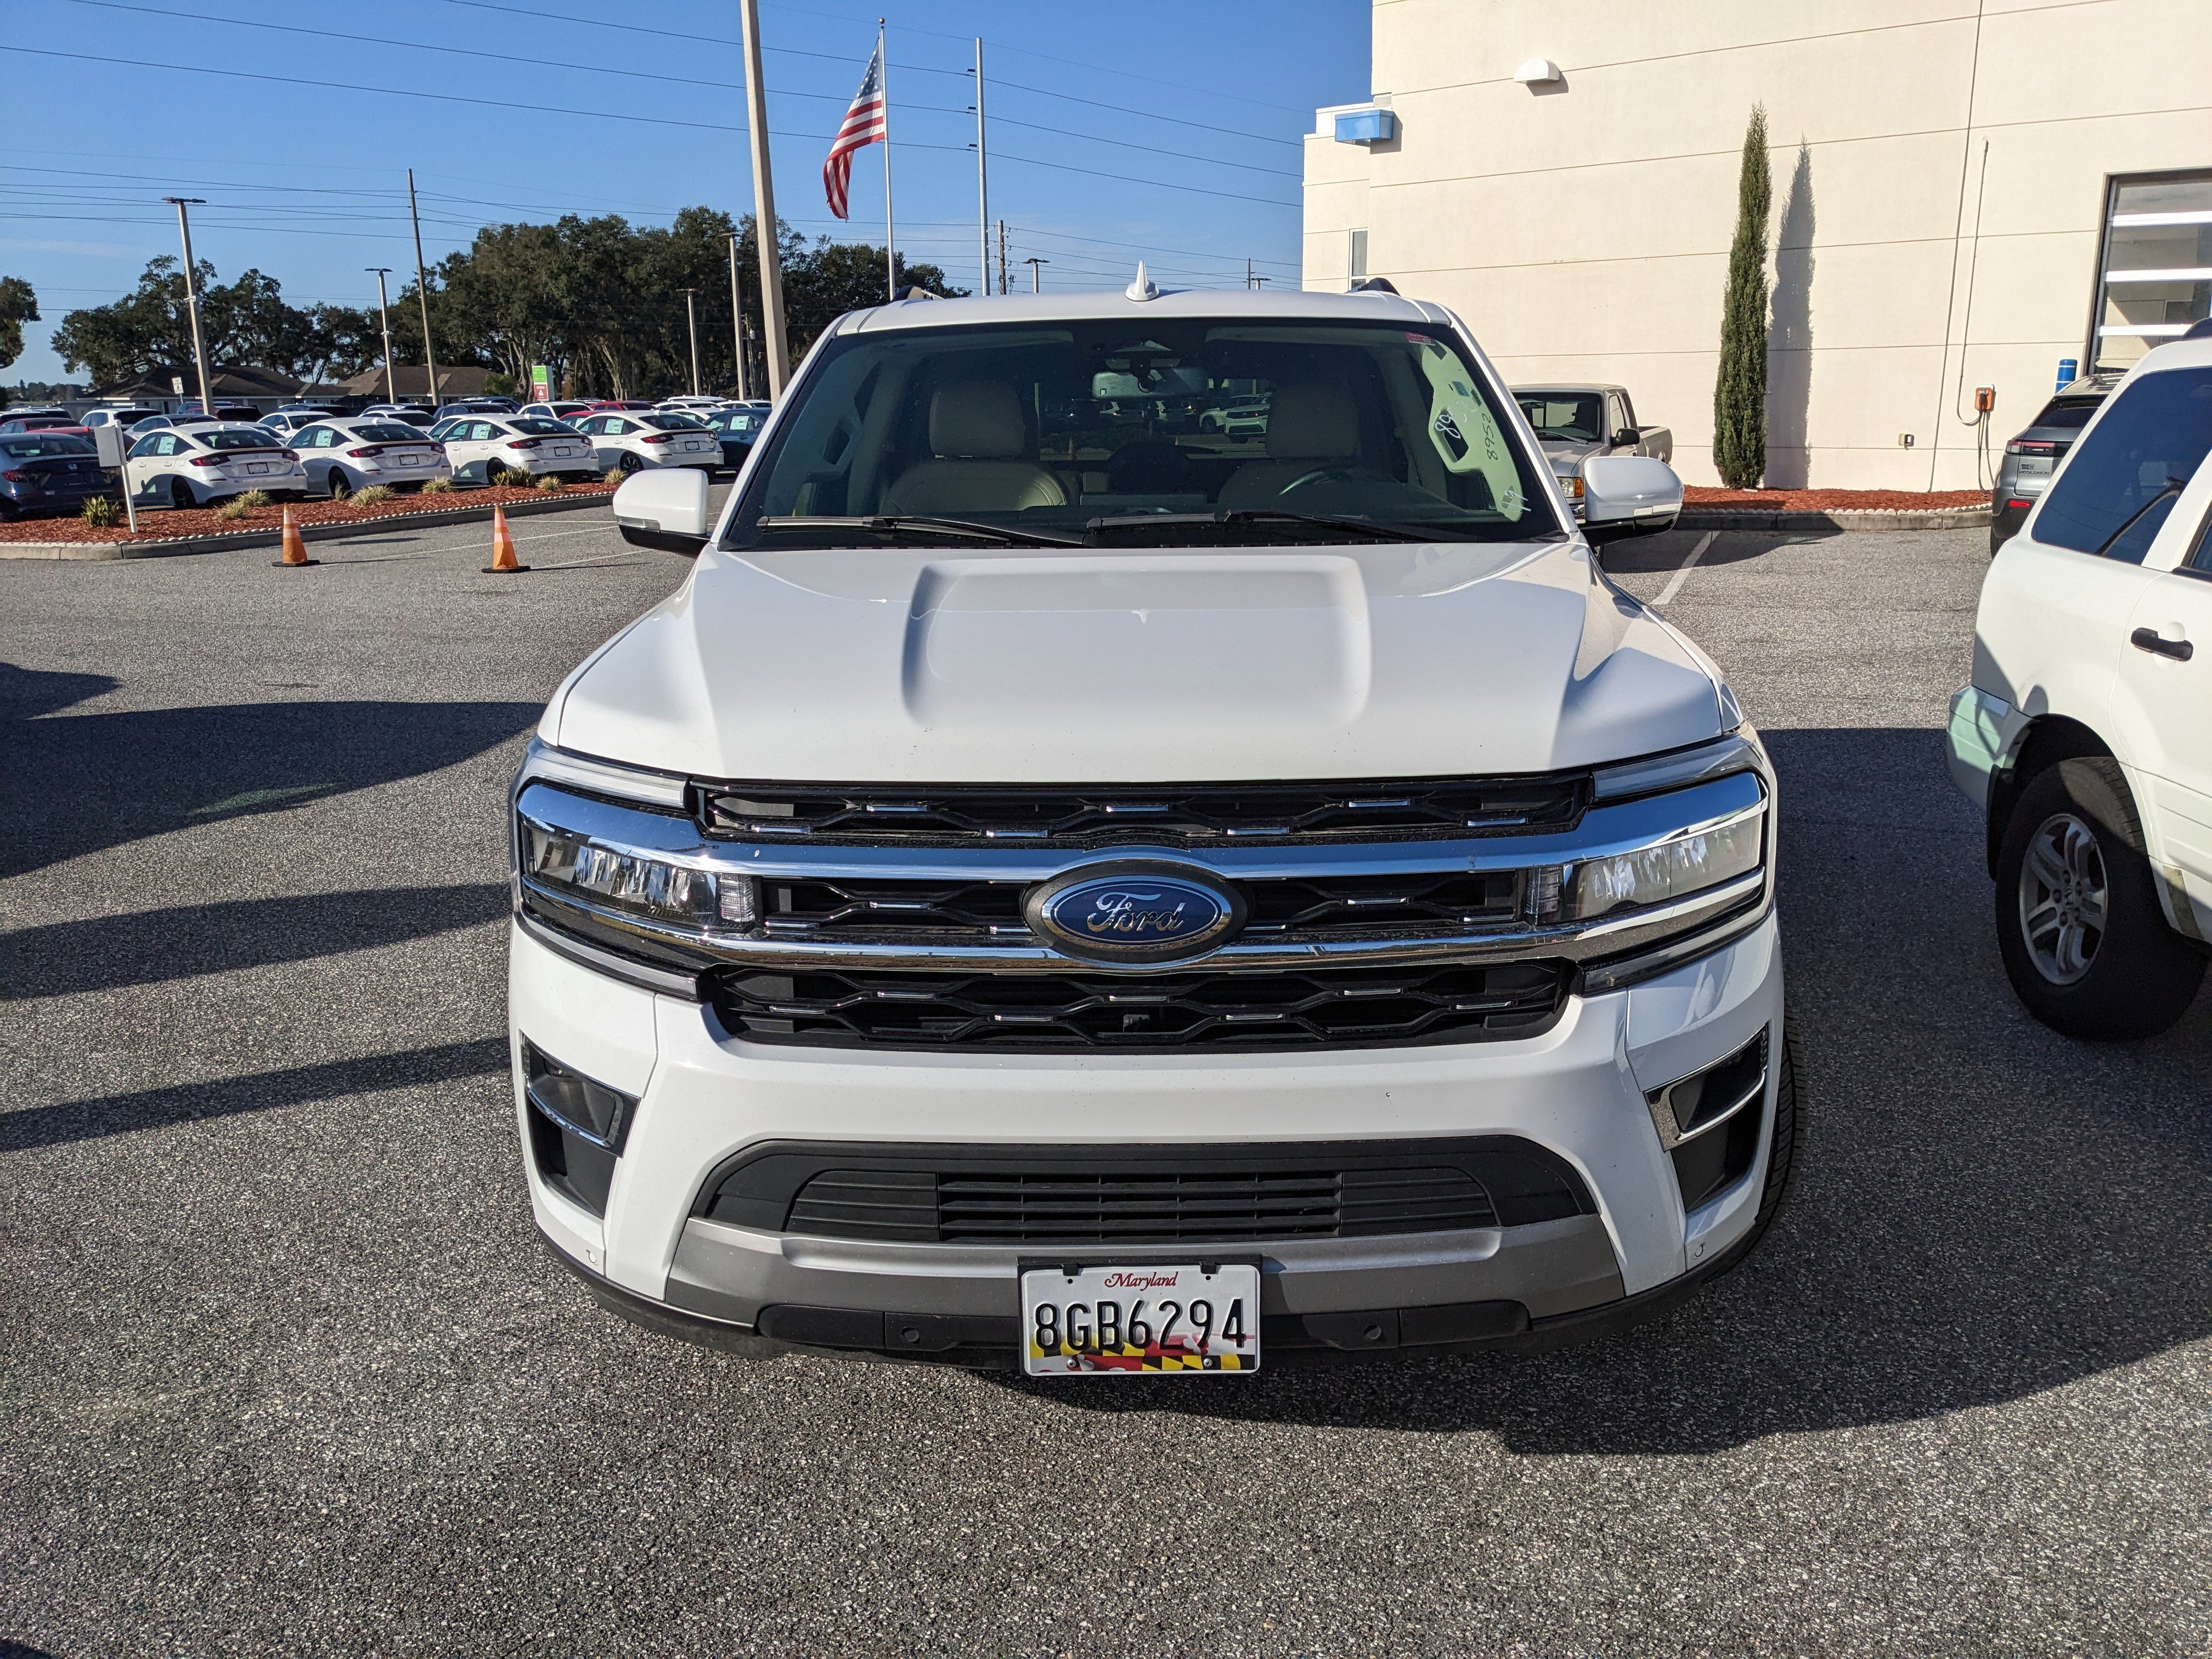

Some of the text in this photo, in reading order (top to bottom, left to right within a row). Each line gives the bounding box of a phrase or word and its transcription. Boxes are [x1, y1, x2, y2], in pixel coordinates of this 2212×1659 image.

[1482, 413, 1498, 460] 8952
[1087, 891, 1185, 932] Ford
[1104, 1271, 1178, 1291] Maryland
[1035, 1298, 1245, 1351] 8GB6294
